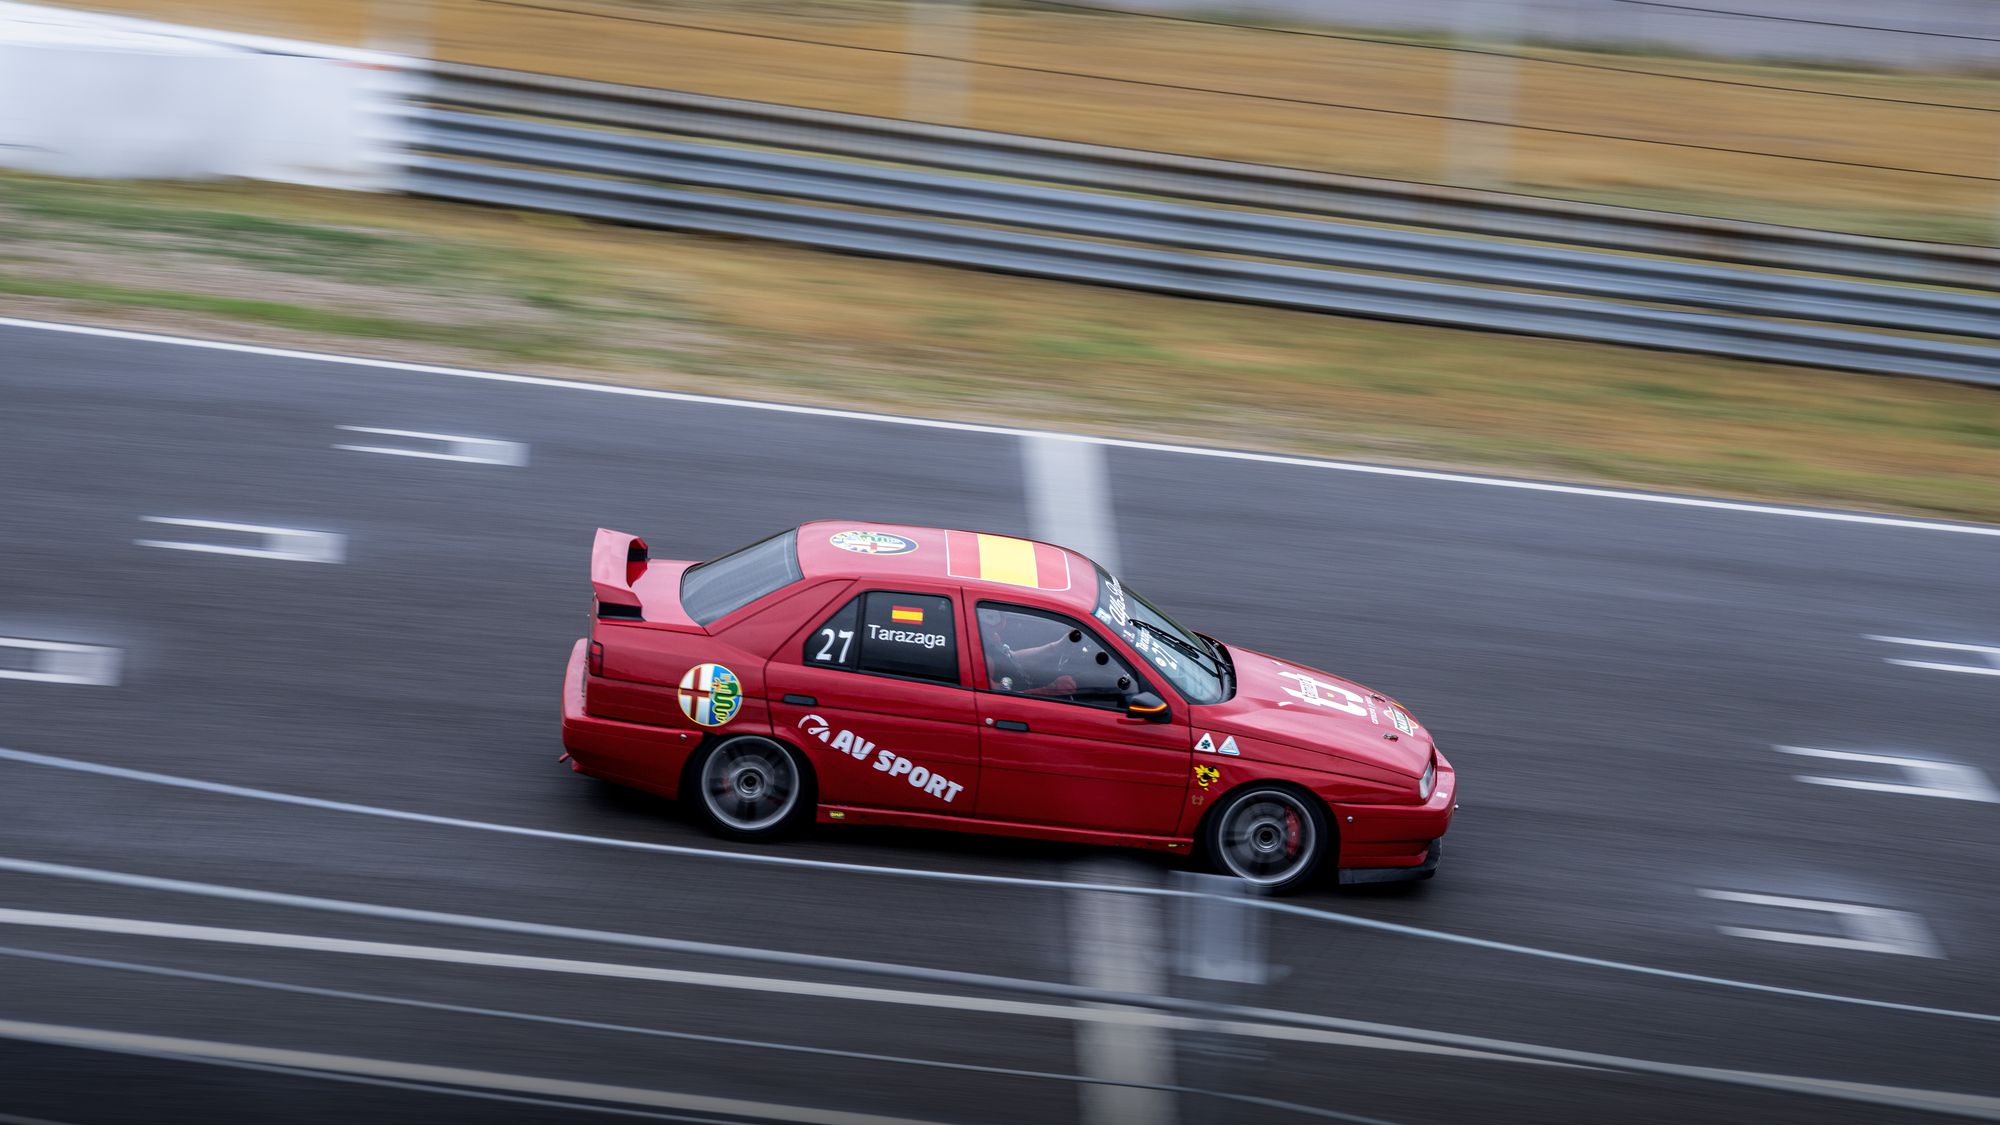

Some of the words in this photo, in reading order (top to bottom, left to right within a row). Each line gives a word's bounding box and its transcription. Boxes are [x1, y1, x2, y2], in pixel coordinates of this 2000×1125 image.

[815, 628, 855, 664] 27
[867, 624, 946, 649] Tarazaga
[830, 729, 876, 760] AV
[872, 749, 964, 803] SPORT
